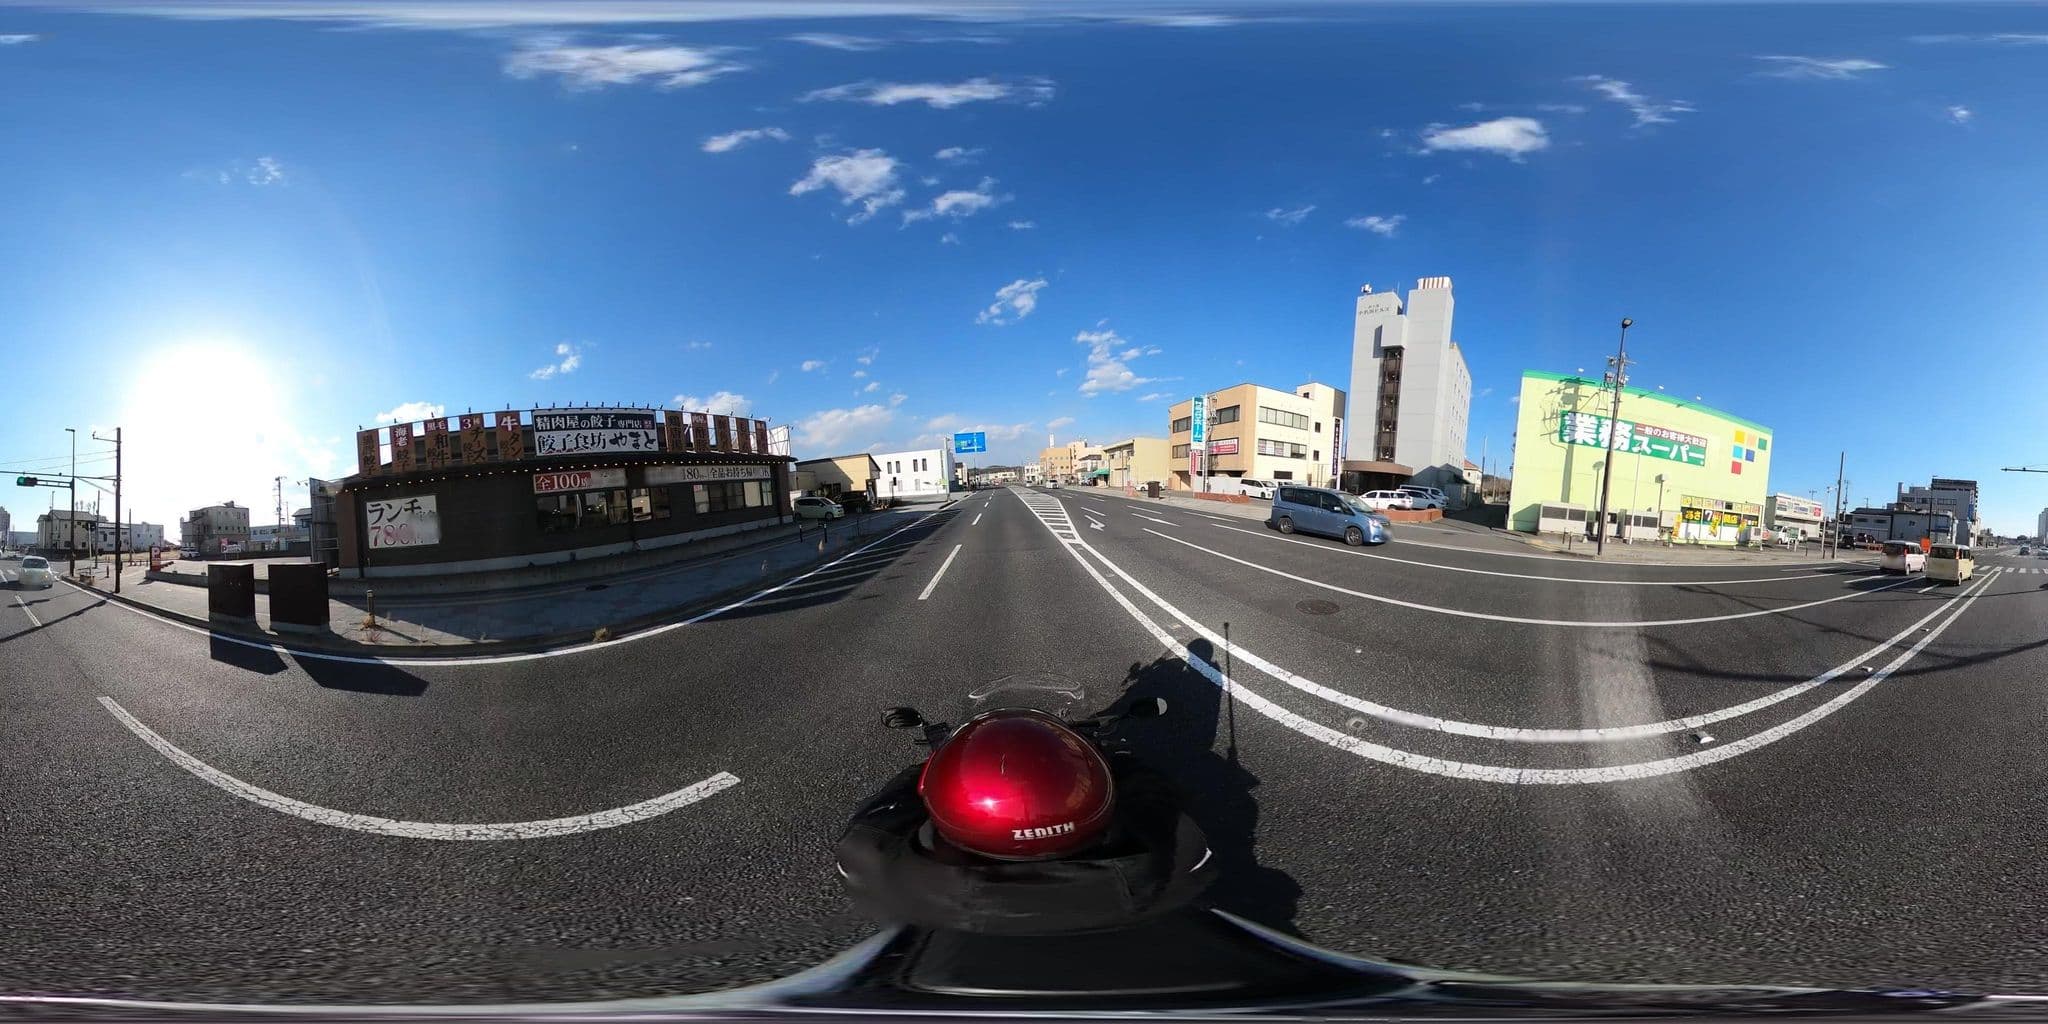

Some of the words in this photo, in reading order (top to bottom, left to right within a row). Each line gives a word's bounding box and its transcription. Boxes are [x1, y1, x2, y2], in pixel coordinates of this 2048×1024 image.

[1562, 411, 1704, 463] 業務スーパー
[368, 499, 421, 525] ランチ
[1011, 821, 1075, 840] ZENITH
